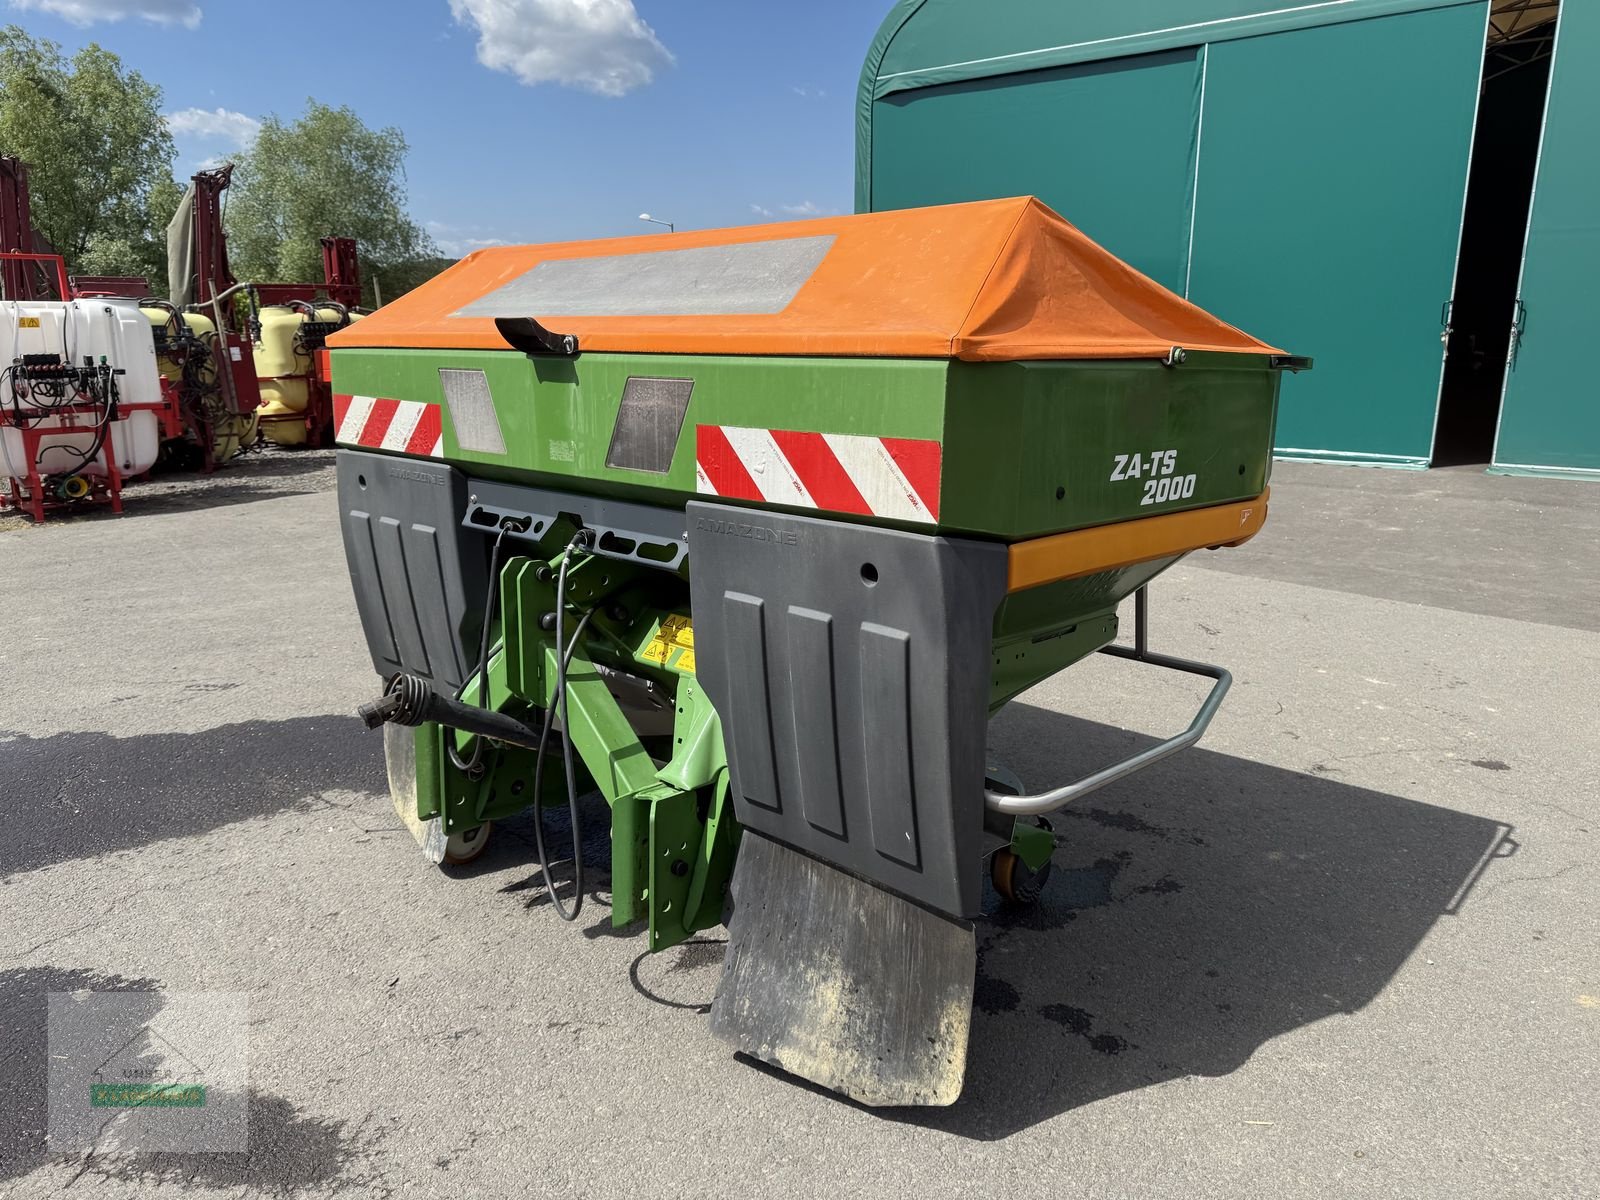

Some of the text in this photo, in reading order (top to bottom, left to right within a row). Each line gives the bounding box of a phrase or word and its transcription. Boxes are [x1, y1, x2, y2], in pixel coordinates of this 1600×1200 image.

[1110, 449, 1178, 482] ZA-TS
[1140, 474, 1197, 506] 2000
[695, 517, 799, 546] AMAZONE
